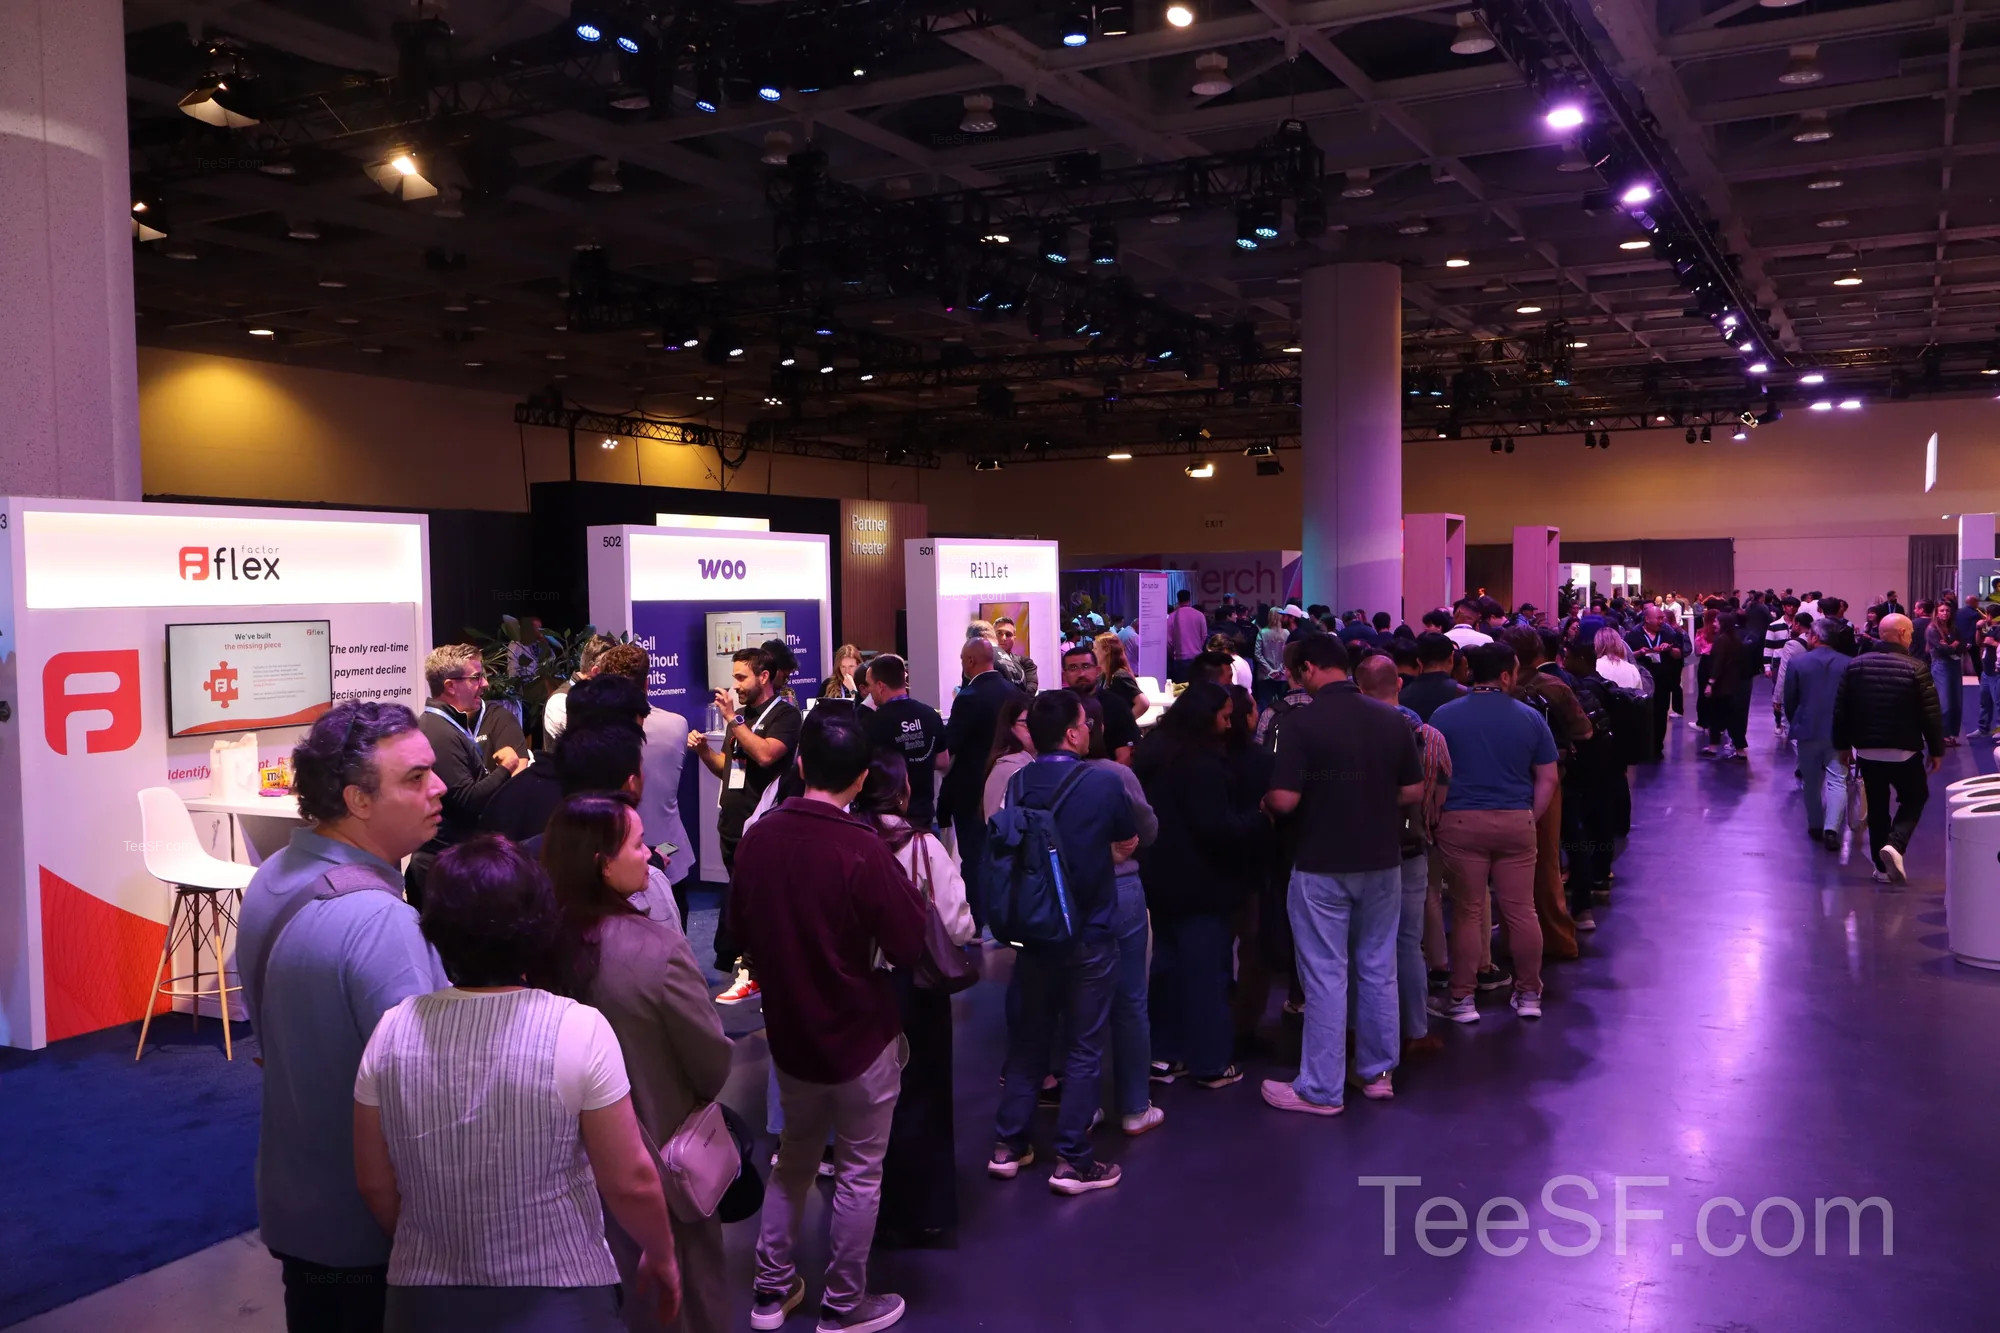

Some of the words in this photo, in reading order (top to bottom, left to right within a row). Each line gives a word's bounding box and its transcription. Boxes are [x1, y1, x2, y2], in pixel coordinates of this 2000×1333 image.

[851, 514, 887, 531] Partner
[1205, 520, 1223, 528] EXIT
[603, 536, 621, 547] 502
[851, 539, 887, 555] theater
[241, 545, 280, 554] factor
[919, 547, 934, 556] 501
[213, 547, 280, 581] flex
[970, 562, 1009, 579] Rillet
[1170, 560, 1276, 595] erch
[256, 632, 271, 640] built
[236, 642, 263, 650] missing
[263, 641, 282, 649] piece
[330, 644, 346, 654] The
[348, 644, 368, 655] only
[369, 642, 409, 653] real-time
[648, 652, 679, 668] thout
[334, 666, 374, 679] payment
[375, 664, 407, 675] decline
[791, 677, 817, 685] ecommerce
[331, 688, 381, 700] decisioning
[383, 686, 412, 698] engine
[901, 718, 922, 733] Sell
[167, 765, 211, 780] Identify
